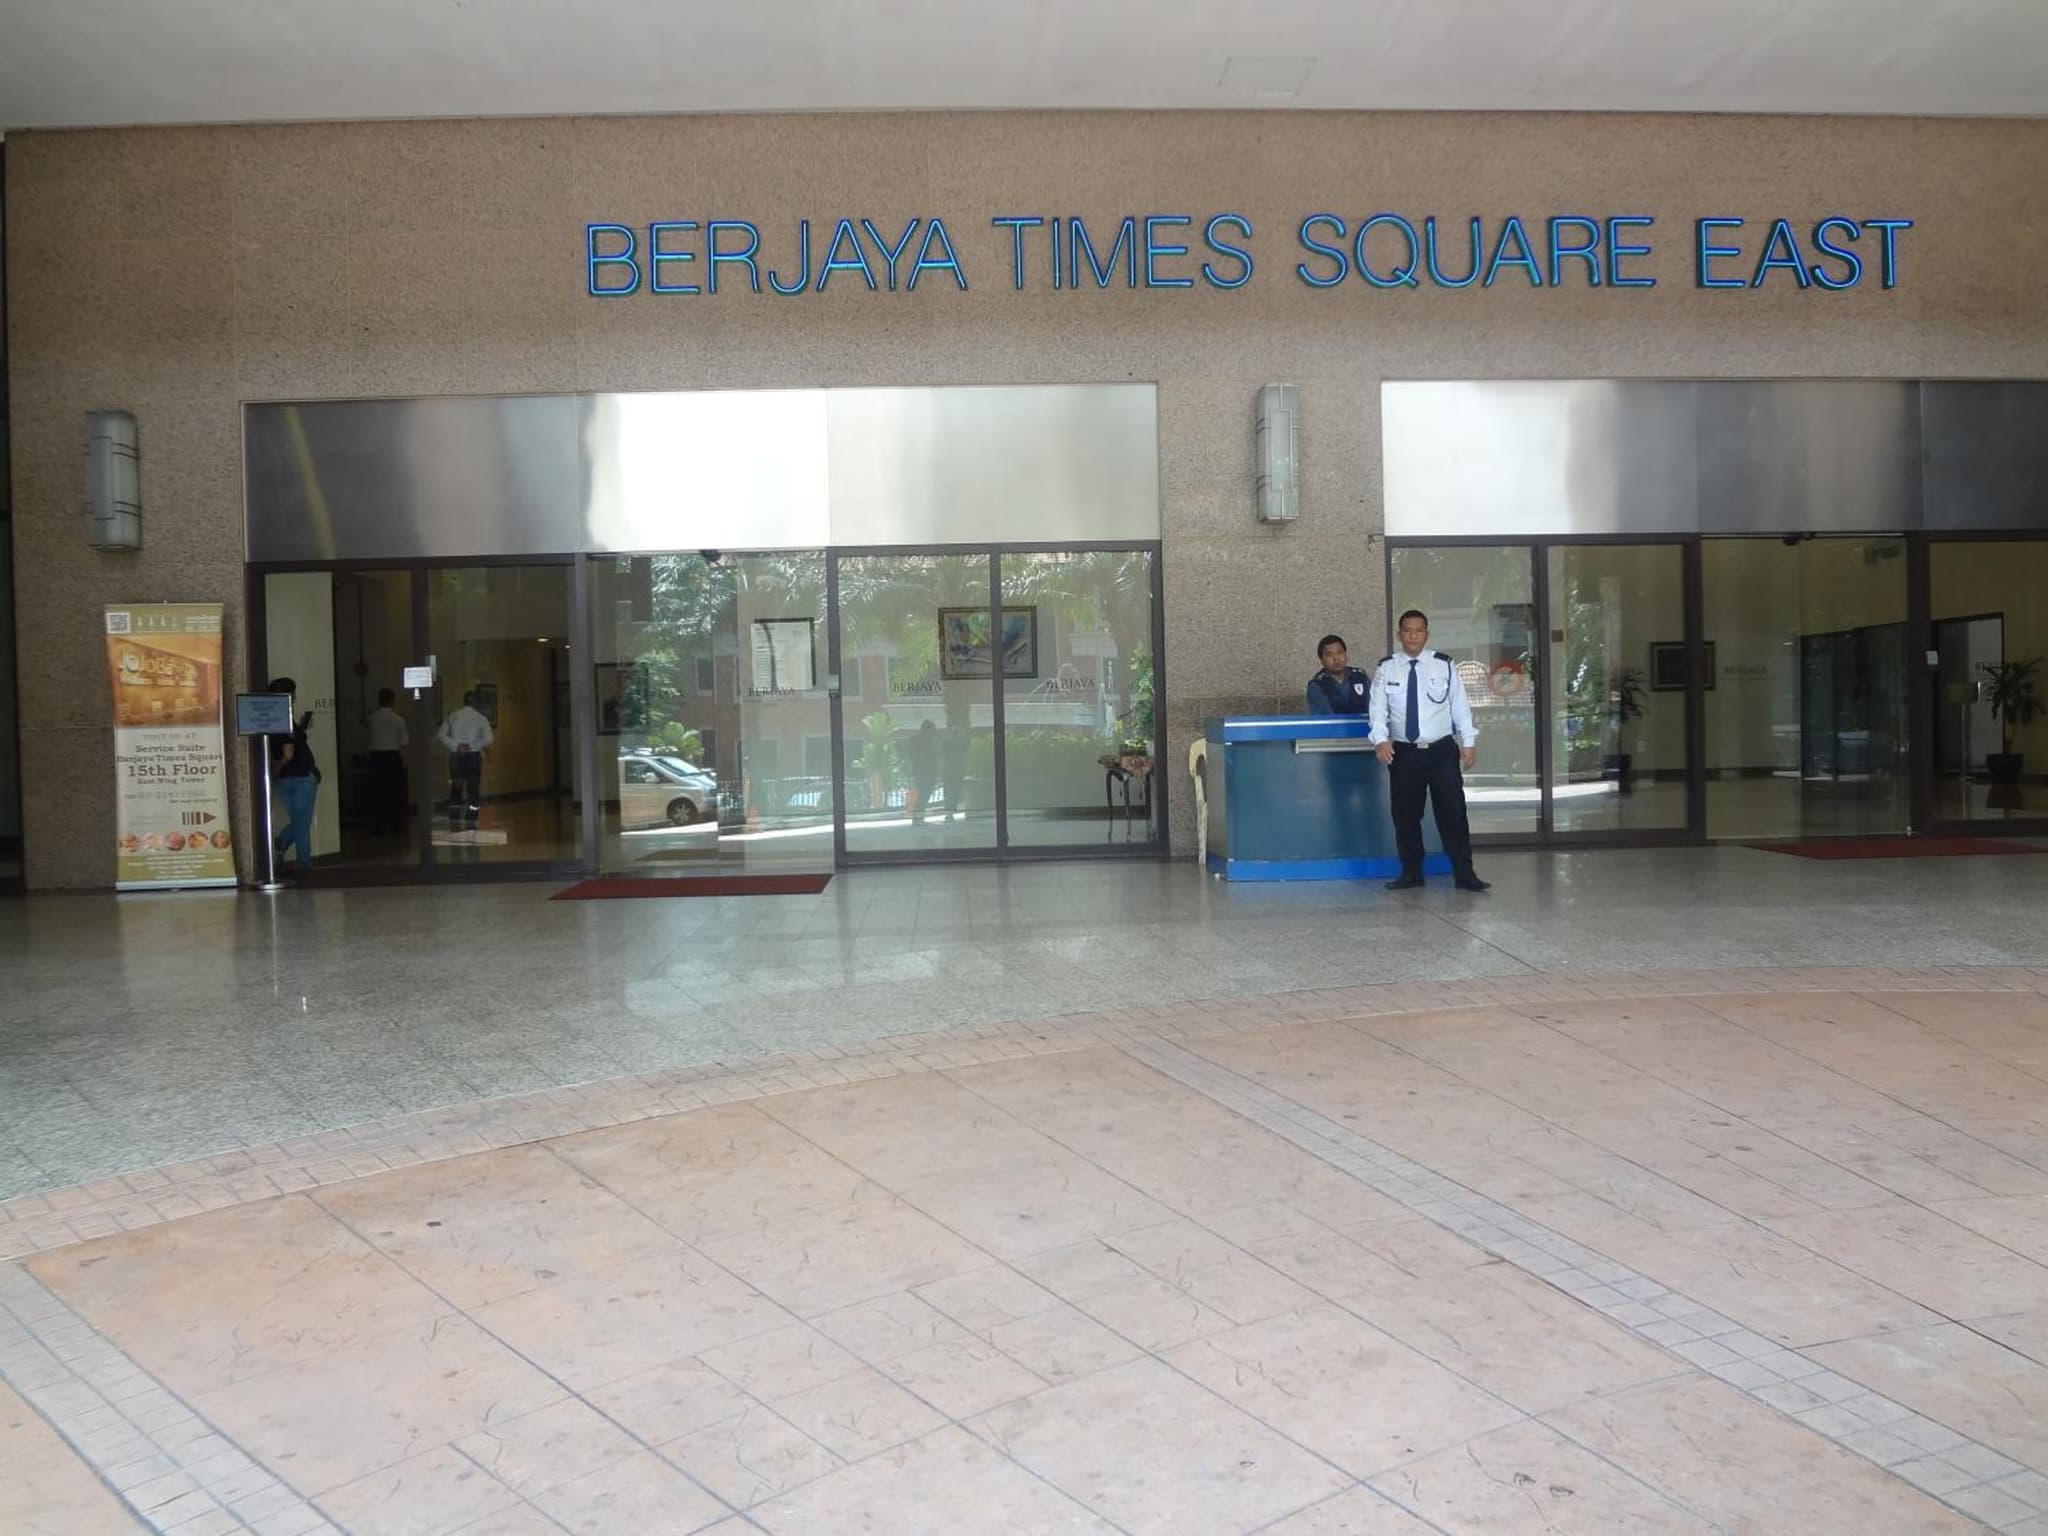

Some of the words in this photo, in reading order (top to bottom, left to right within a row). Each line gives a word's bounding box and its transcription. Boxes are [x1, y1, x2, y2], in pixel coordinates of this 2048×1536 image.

[586, 218, 967, 296] BERJAYA
[992, 213, 1254, 290] TIMES
[1296, 213, 1655, 290] SQUARE
[1696, 216, 1912, 290] EAST
[135, 744, 175, 753] Service
[178, 743, 206, 752] Suite
[156, 754, 186, 762] Times
[128, 764, 167, 777] 15th
[172, 764, 217, 775] Floor
